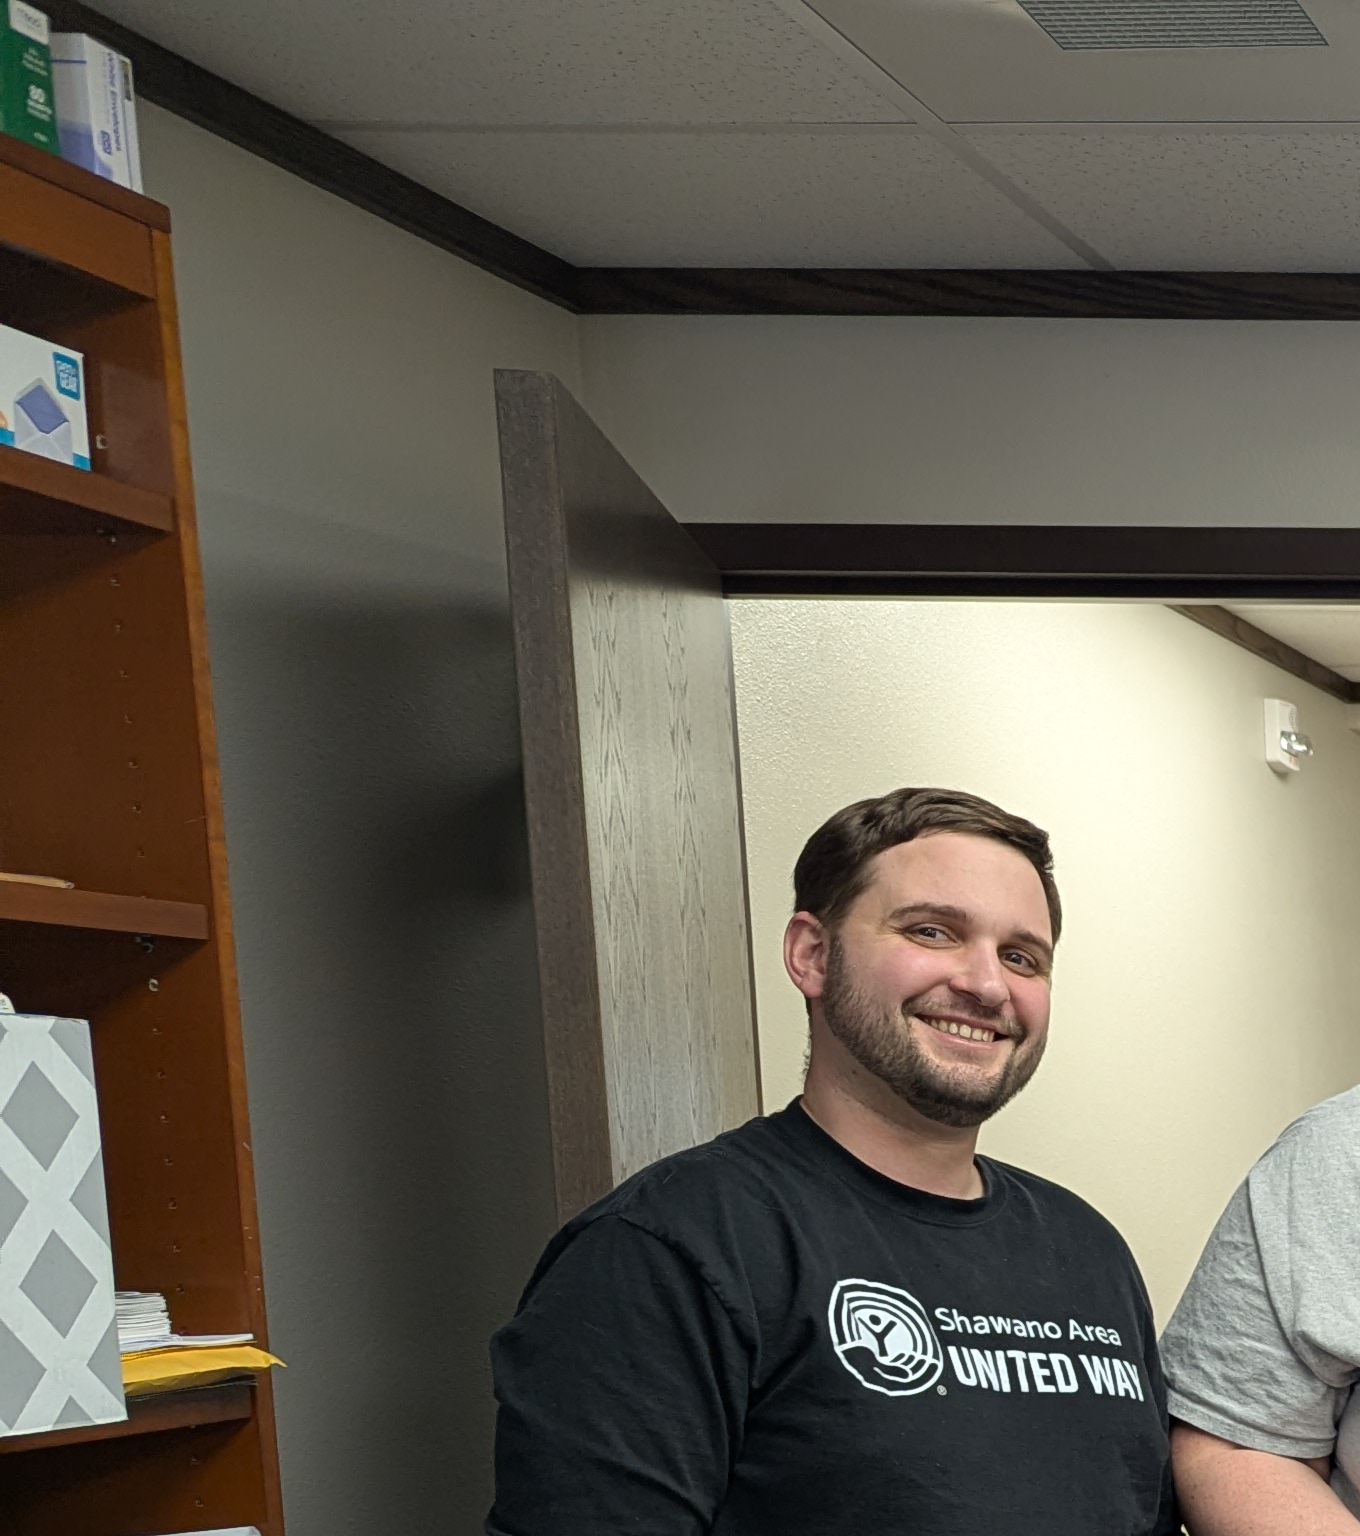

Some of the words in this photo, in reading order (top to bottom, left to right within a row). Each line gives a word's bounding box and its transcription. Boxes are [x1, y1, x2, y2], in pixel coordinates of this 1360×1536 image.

[935, 1307, 1063, 1339] Shawano
[1068, 1318, 1123, 1347] Area
[946, 1345, 1079, 1393] UNITED
[1078, 1354, 1145, 1402] WAY
